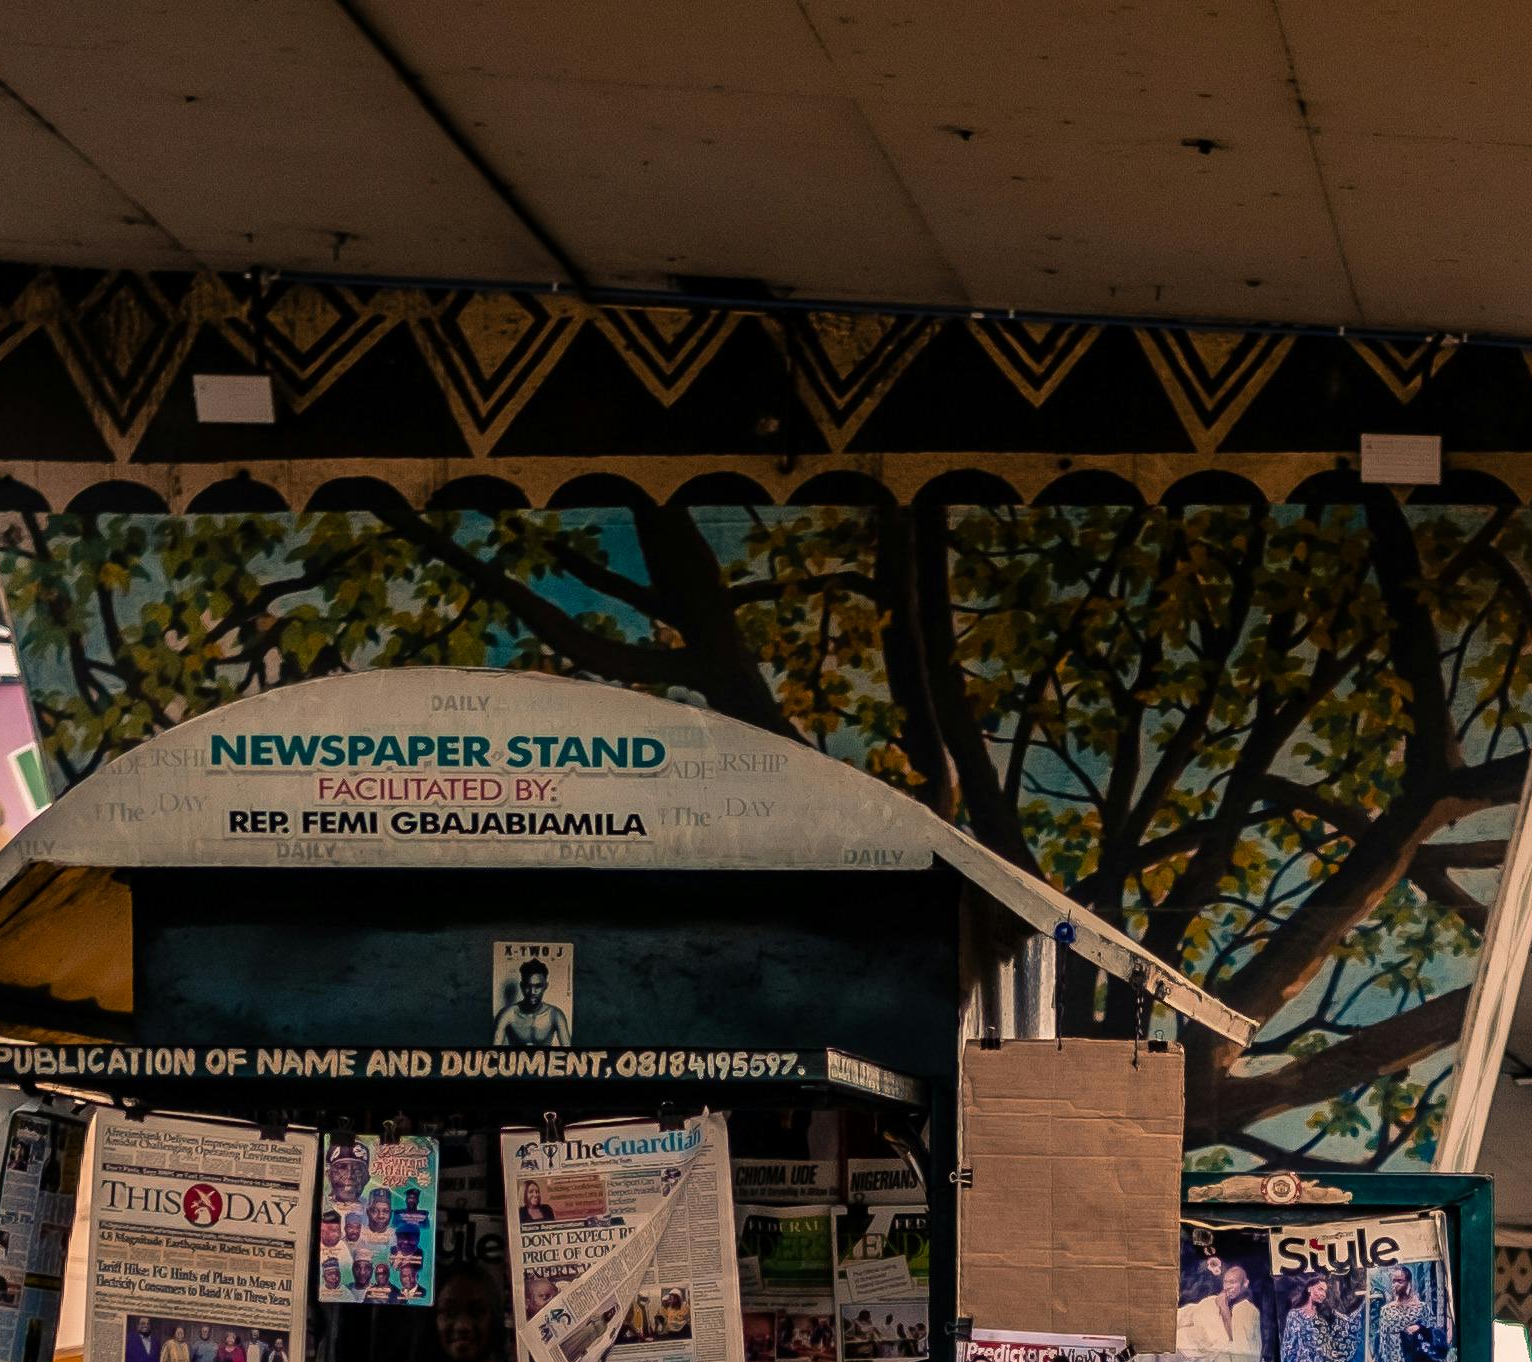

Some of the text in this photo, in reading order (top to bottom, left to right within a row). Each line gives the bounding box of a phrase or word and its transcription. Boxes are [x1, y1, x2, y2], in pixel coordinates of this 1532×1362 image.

[211, 735, 667, 768] NEWSPAPER STAND
[318, 777, 556, 801] FACILITATED BY:
[228, 811, 647, 836] REP. FEMI GBAJABIAMILA
[206, 1047, 248, 1077] OF
[257, 1047, 357, 1078] NAME
[366, 1048, 433, 1079] AND
[440, 1050, 613, 1081] DUCUMENT,
[616, 1049, 806, 1081] 08184195597.
[100, 1180, 297, 1227] THIS DAY
[520, 1228, 615, 1248] DON'T EXPECT
[522, 1246, 582, 1264] PRICE OF
[1278, 1228, 1401, 1276] Style
[152, 1265, 168, 1278] FG
[170, 1267, 198, 1281] Hints
[199, 1269, 211, 1283] of
[213, 1271, 235, 1284] Plan
[277, 1279, 293, 1292] All
[137, 1279, 186, 1296] Consumers
[187, 1283, 197, 1296] to
[199, 1285, 221, 1299] Band
[244, 1290, 267, 1304] Three
[268, 1293, 291, 1307] Years
